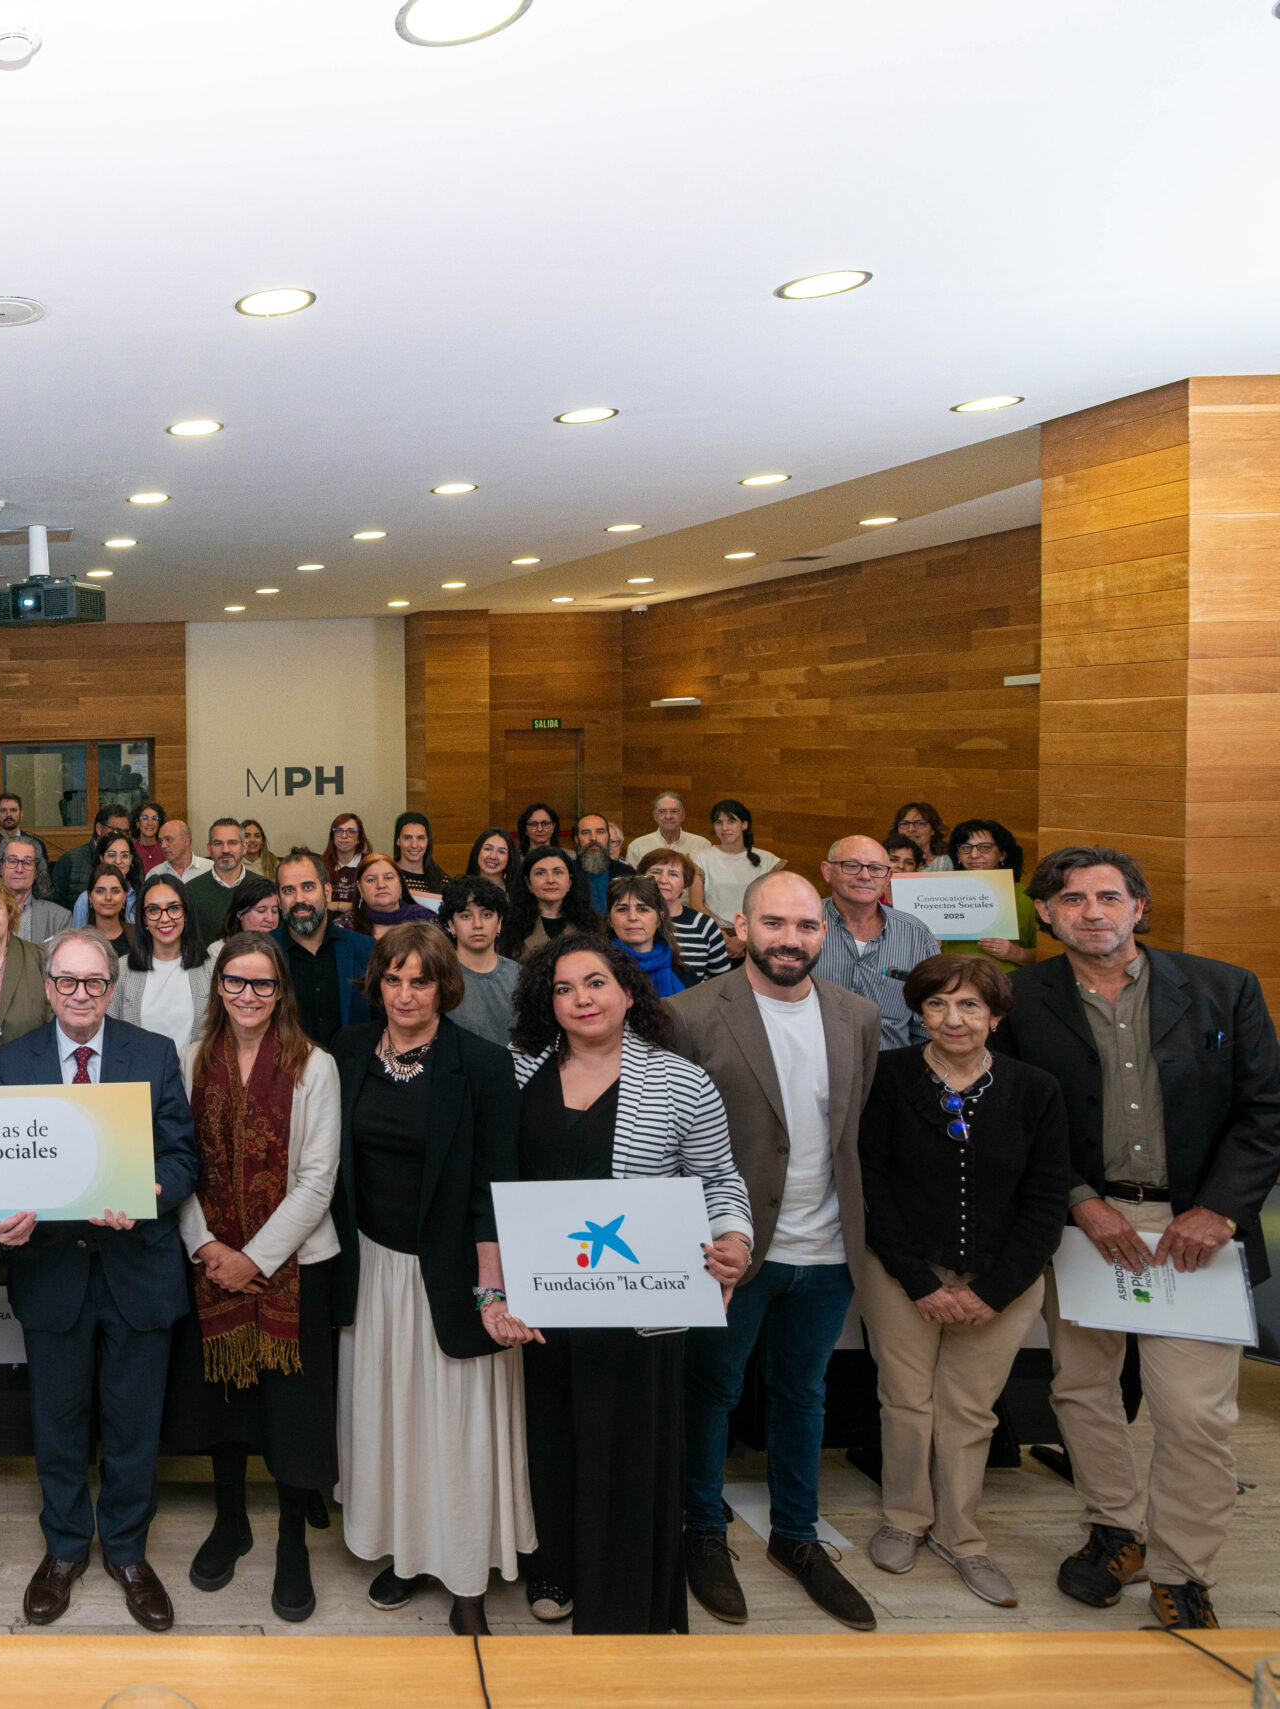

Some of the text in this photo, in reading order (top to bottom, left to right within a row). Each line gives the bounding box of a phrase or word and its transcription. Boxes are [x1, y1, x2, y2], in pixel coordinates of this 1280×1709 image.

[534, 719, 559, 729] SALIDA
[246, 765, 344, 797] MPH
[916, 893, 990, 902] Convocatorias de
[914, 901, 994, 910] Proyectos Sociales
[26, 1118, 49, 1137] de
[532, 1276, 615, 1292] Fundación
